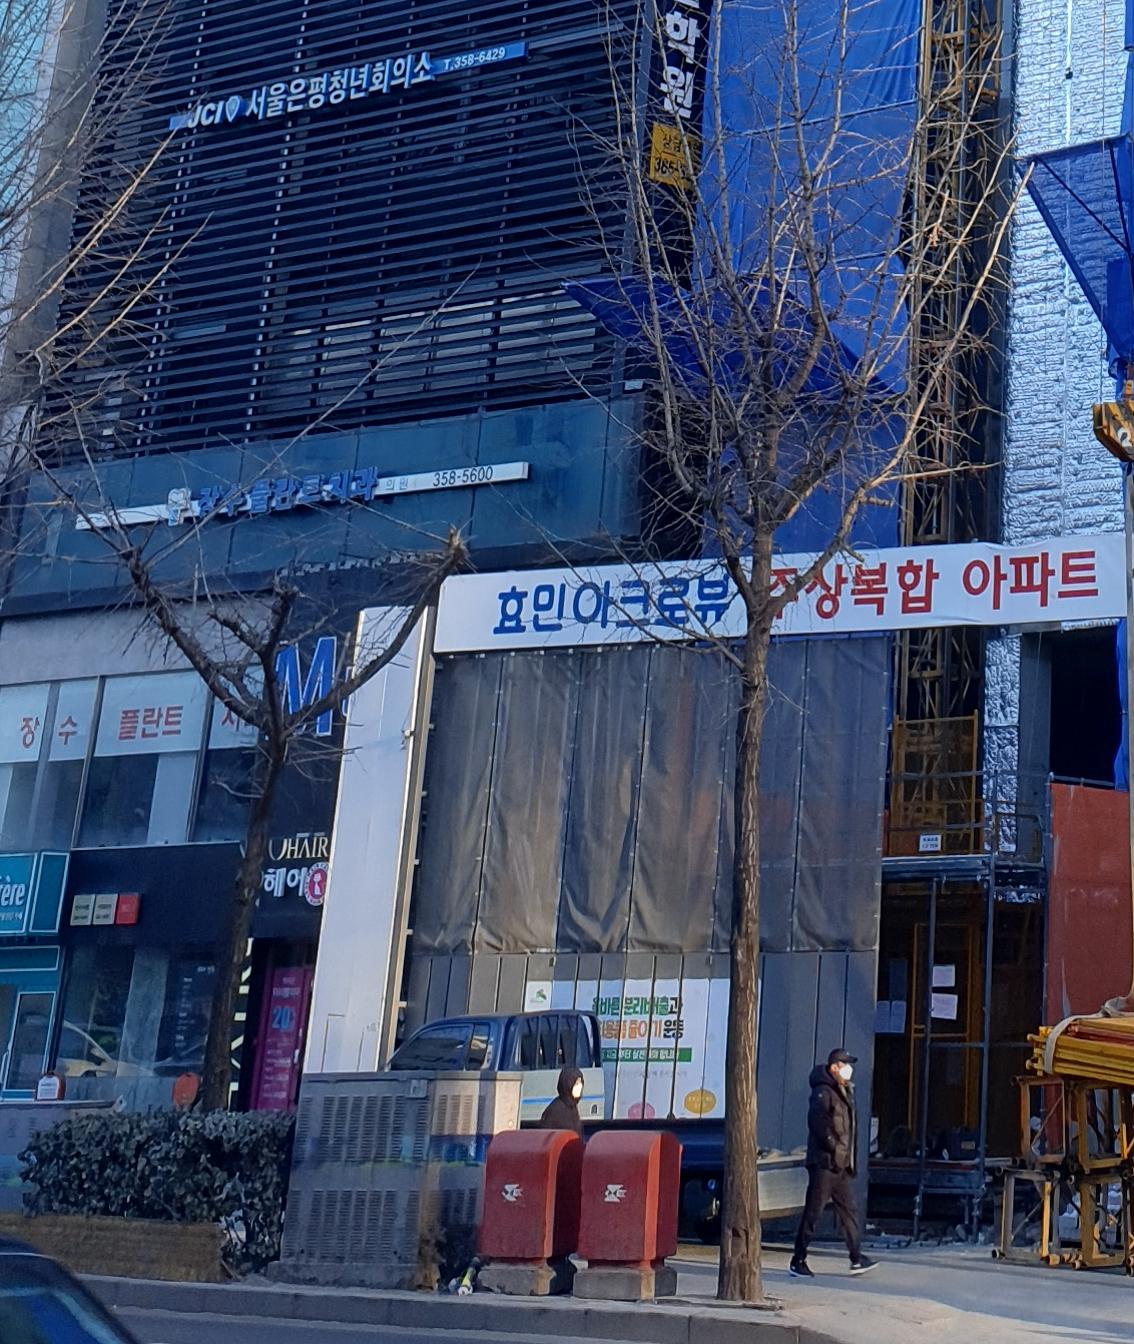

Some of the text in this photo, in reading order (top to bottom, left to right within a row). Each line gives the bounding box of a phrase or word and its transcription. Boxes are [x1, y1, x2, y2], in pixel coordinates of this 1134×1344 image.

[188, 46, 506, 129] JCI 서울은평청년회의소 T.358-6429
[432, 465, 494, 487] 358-5600
[493, 573, 730, 635] 효민아크로뷰
[769, 559, 940, 620] 주상복합
[963, 550, 1099, 610] 아파트
[118, 705, 183, 742] 플란트
